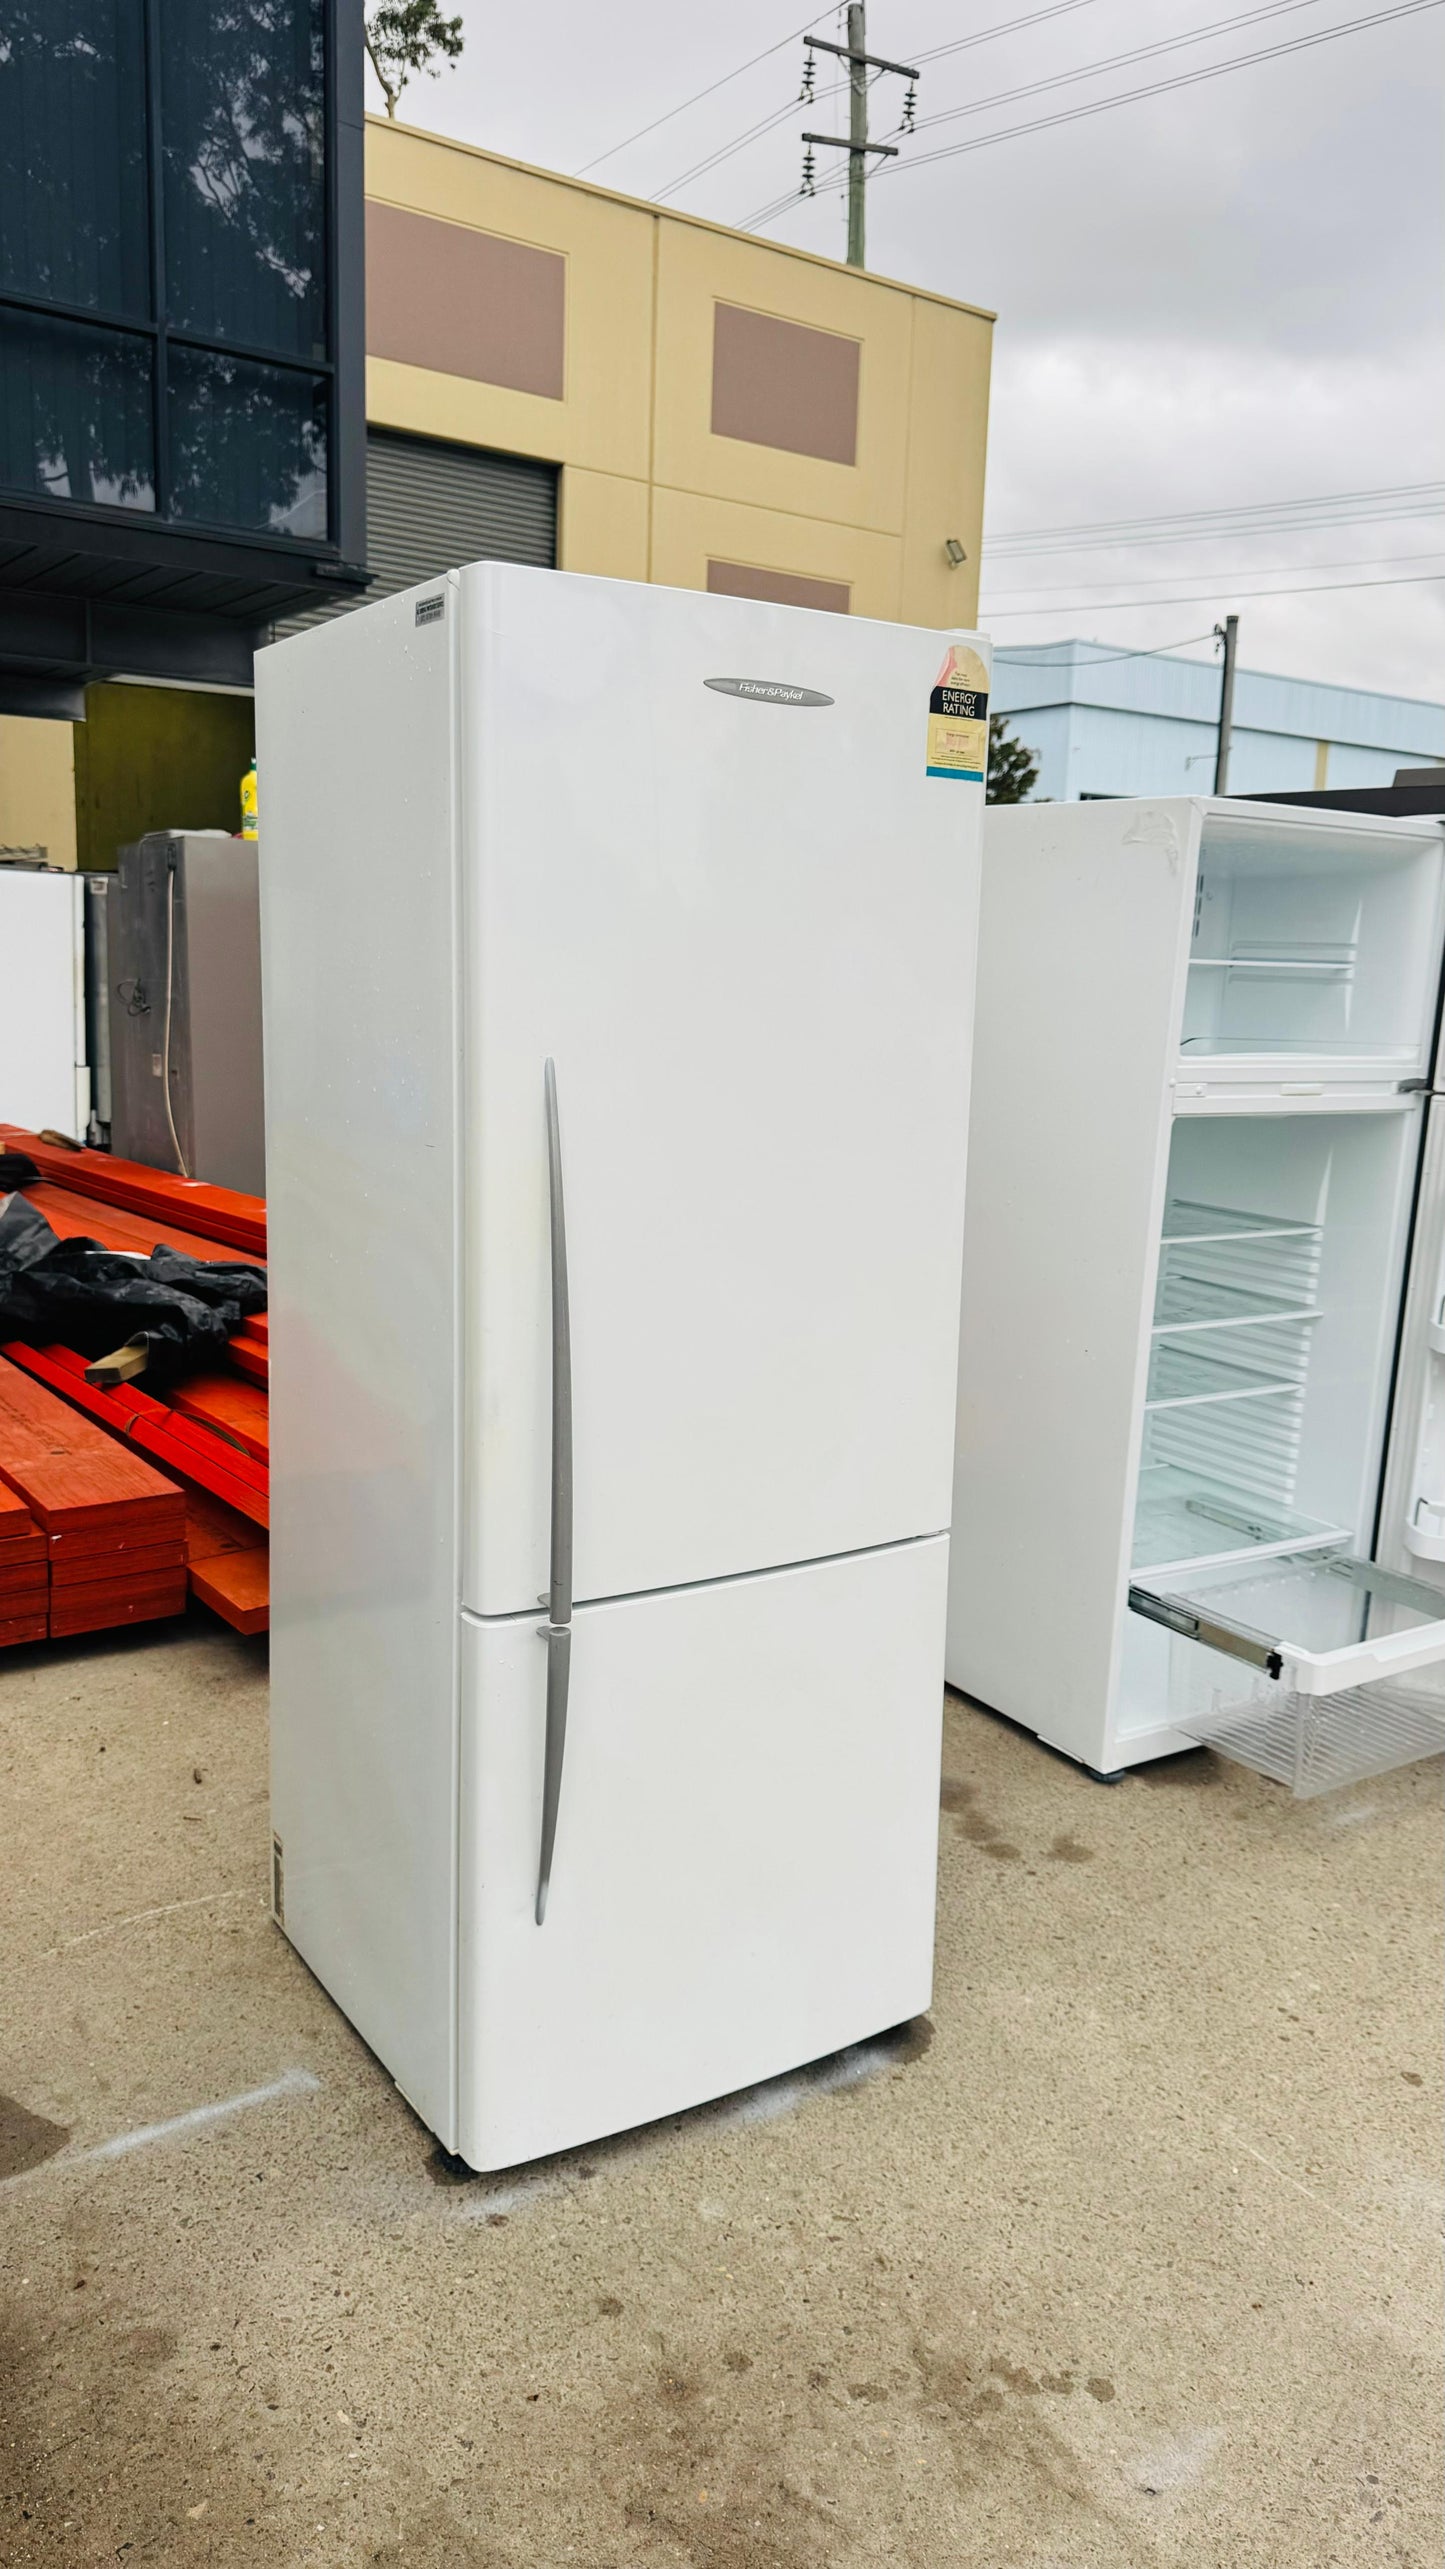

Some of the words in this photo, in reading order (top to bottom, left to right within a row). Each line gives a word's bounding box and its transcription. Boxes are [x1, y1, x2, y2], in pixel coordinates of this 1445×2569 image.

[739, 683, 804, 701] Fisher&Paykel
[942, 689, 977, 705] ENERGY
[943, 702, 975, 717] RATING
